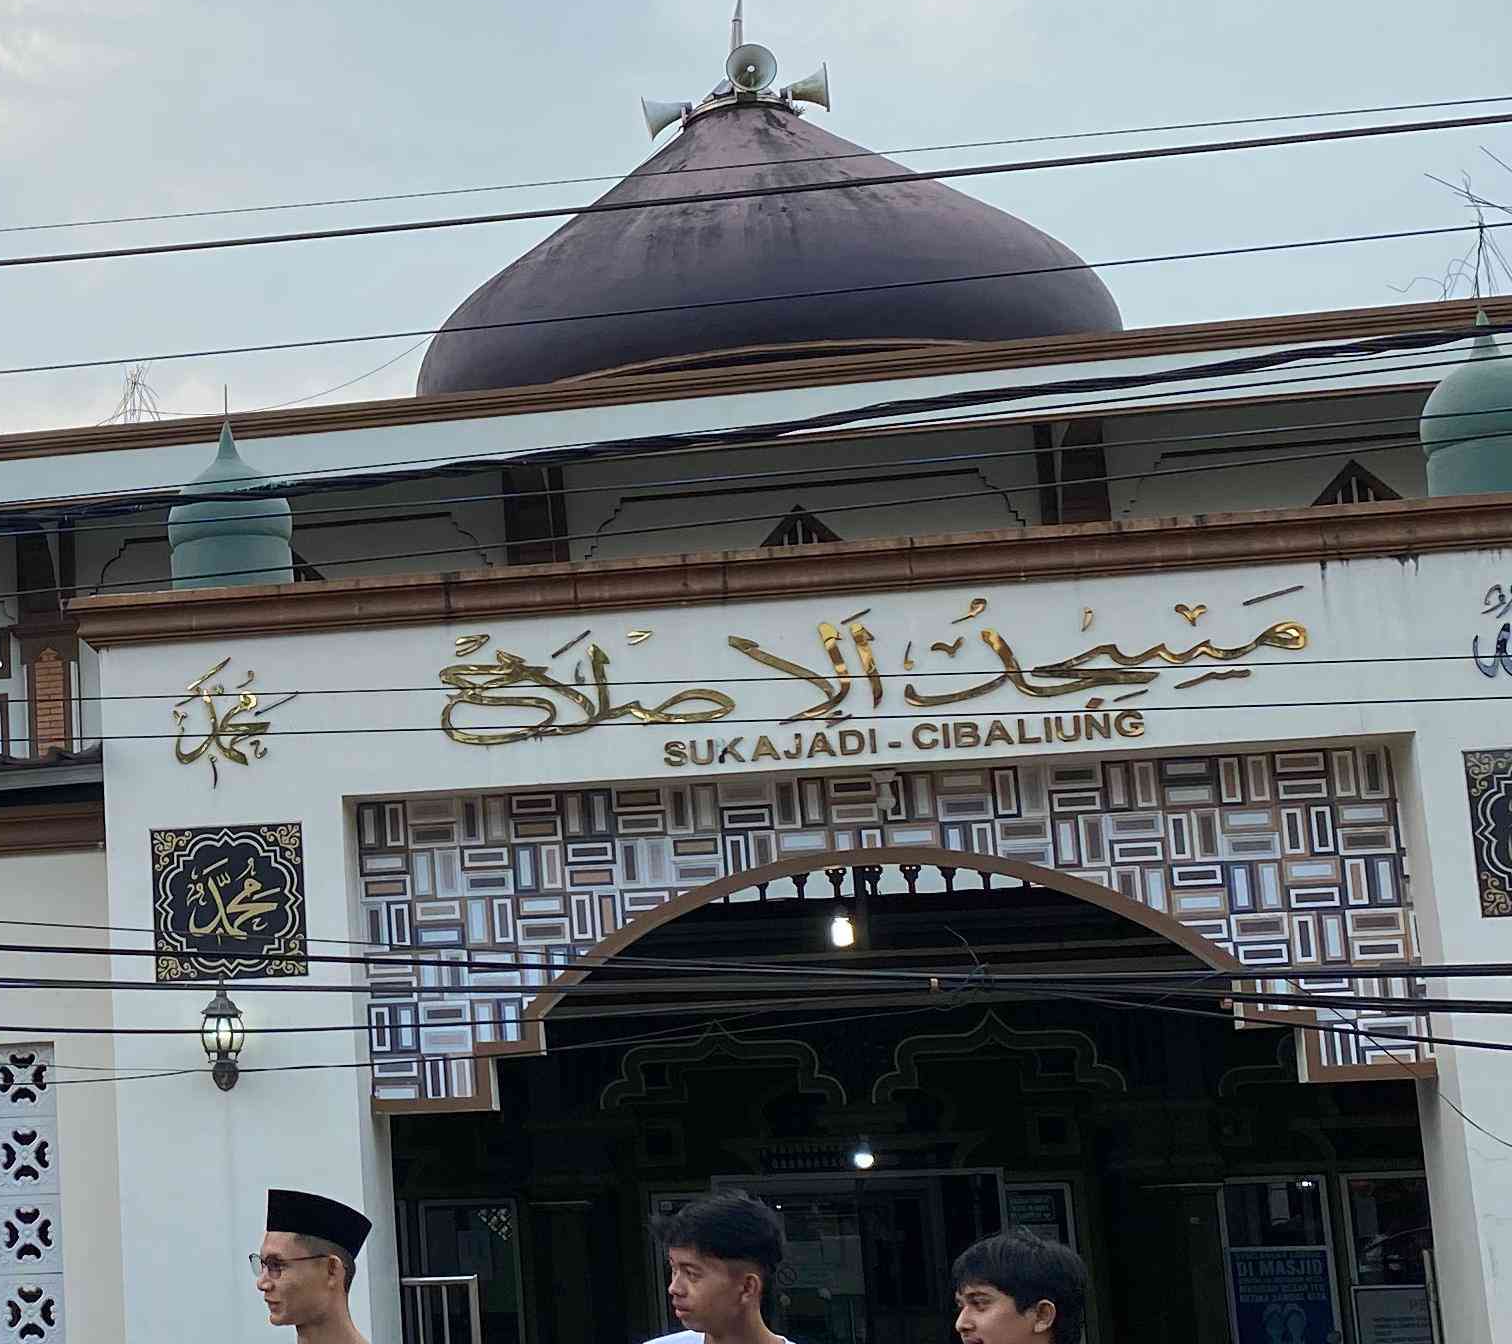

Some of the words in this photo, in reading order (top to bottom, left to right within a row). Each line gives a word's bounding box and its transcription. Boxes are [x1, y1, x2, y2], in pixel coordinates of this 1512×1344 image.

[663, 727, 878, 767] SUKAJADI
[912, 710, 1145, 750] CIBALIUNG
[1259, 1259, 1323, 1276] MASJID
